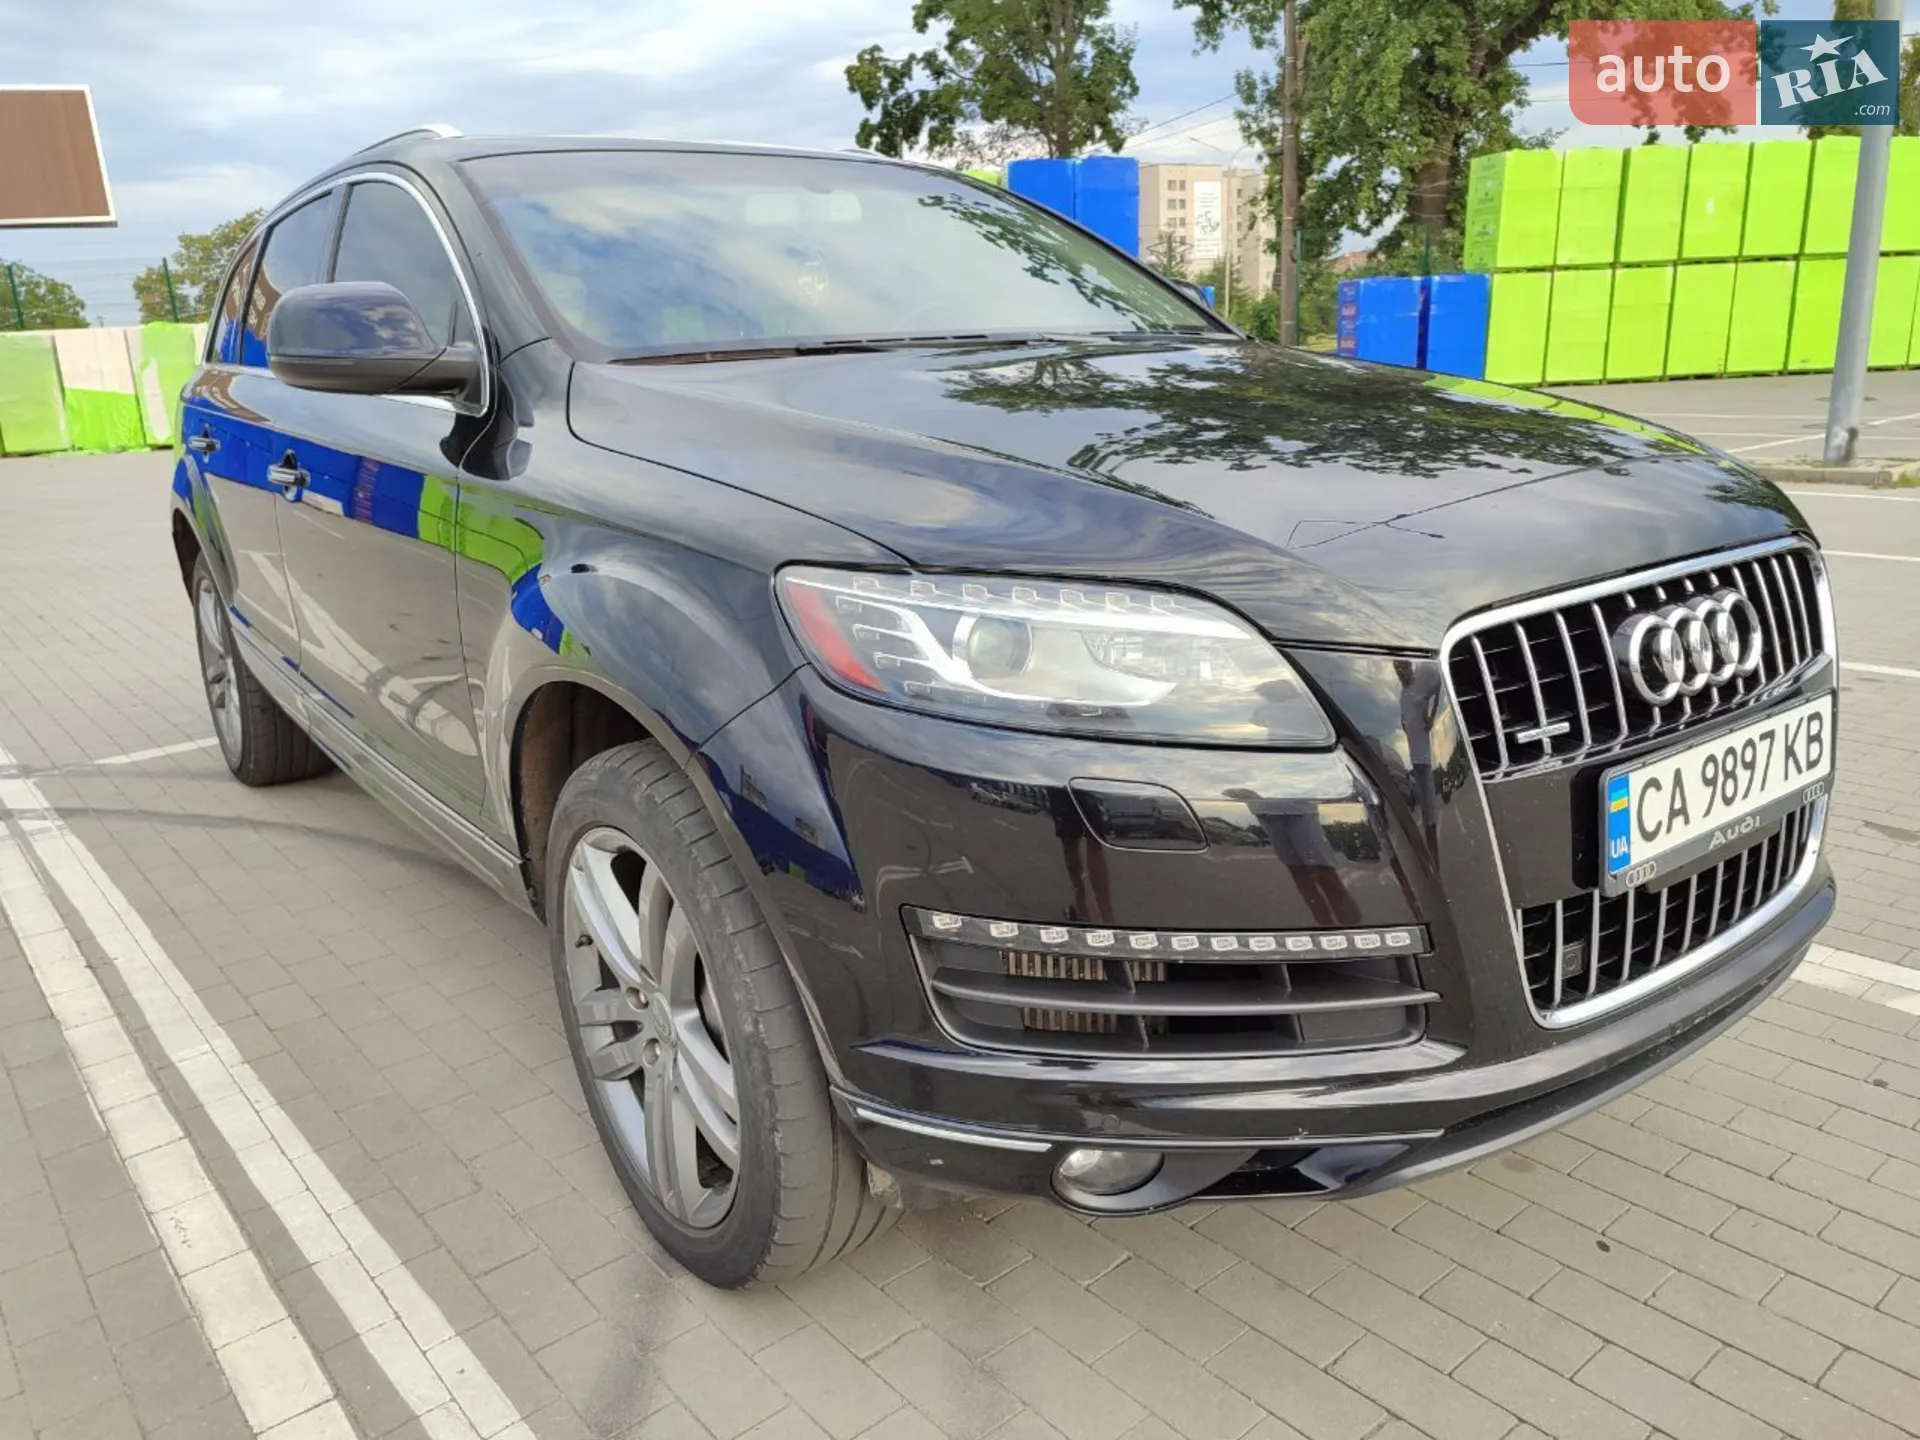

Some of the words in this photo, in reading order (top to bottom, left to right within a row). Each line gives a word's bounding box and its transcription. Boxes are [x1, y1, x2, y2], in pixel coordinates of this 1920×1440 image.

[1636, 767, 1690, 843] CA
[1701, 729, 1775, 819] 9897
[1784, 710, 1824, 782] KB
[1610, 836, 1629, 859] UA
[1708, 815, 1761, 850] Audi
